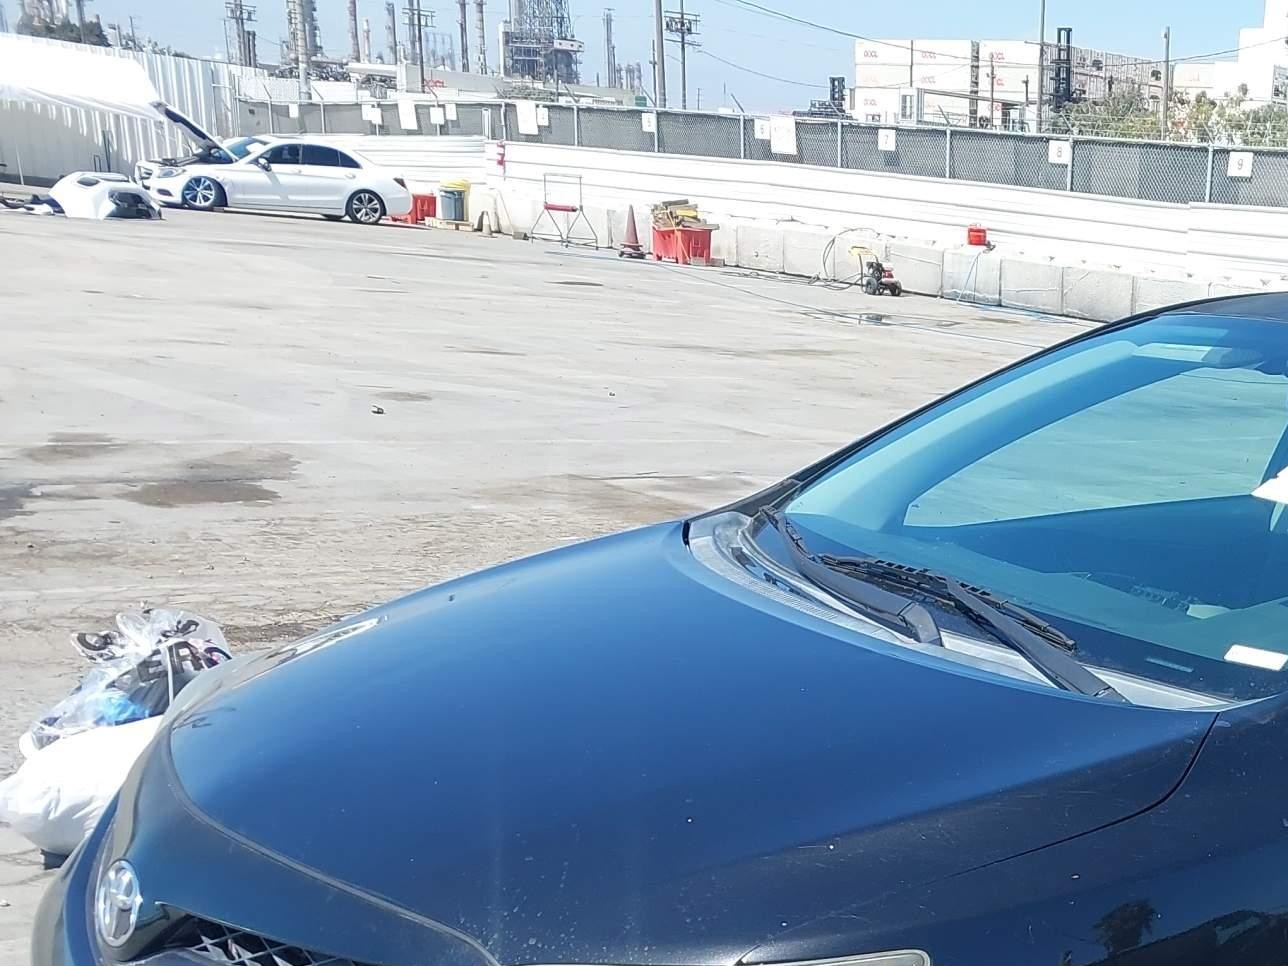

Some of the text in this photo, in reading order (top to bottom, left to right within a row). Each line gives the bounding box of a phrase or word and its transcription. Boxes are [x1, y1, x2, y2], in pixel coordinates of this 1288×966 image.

[883, 134, 889, 145] 7
[1056, 146, 1063, 158] 8
[1237, 158, 1244, 170] 9
